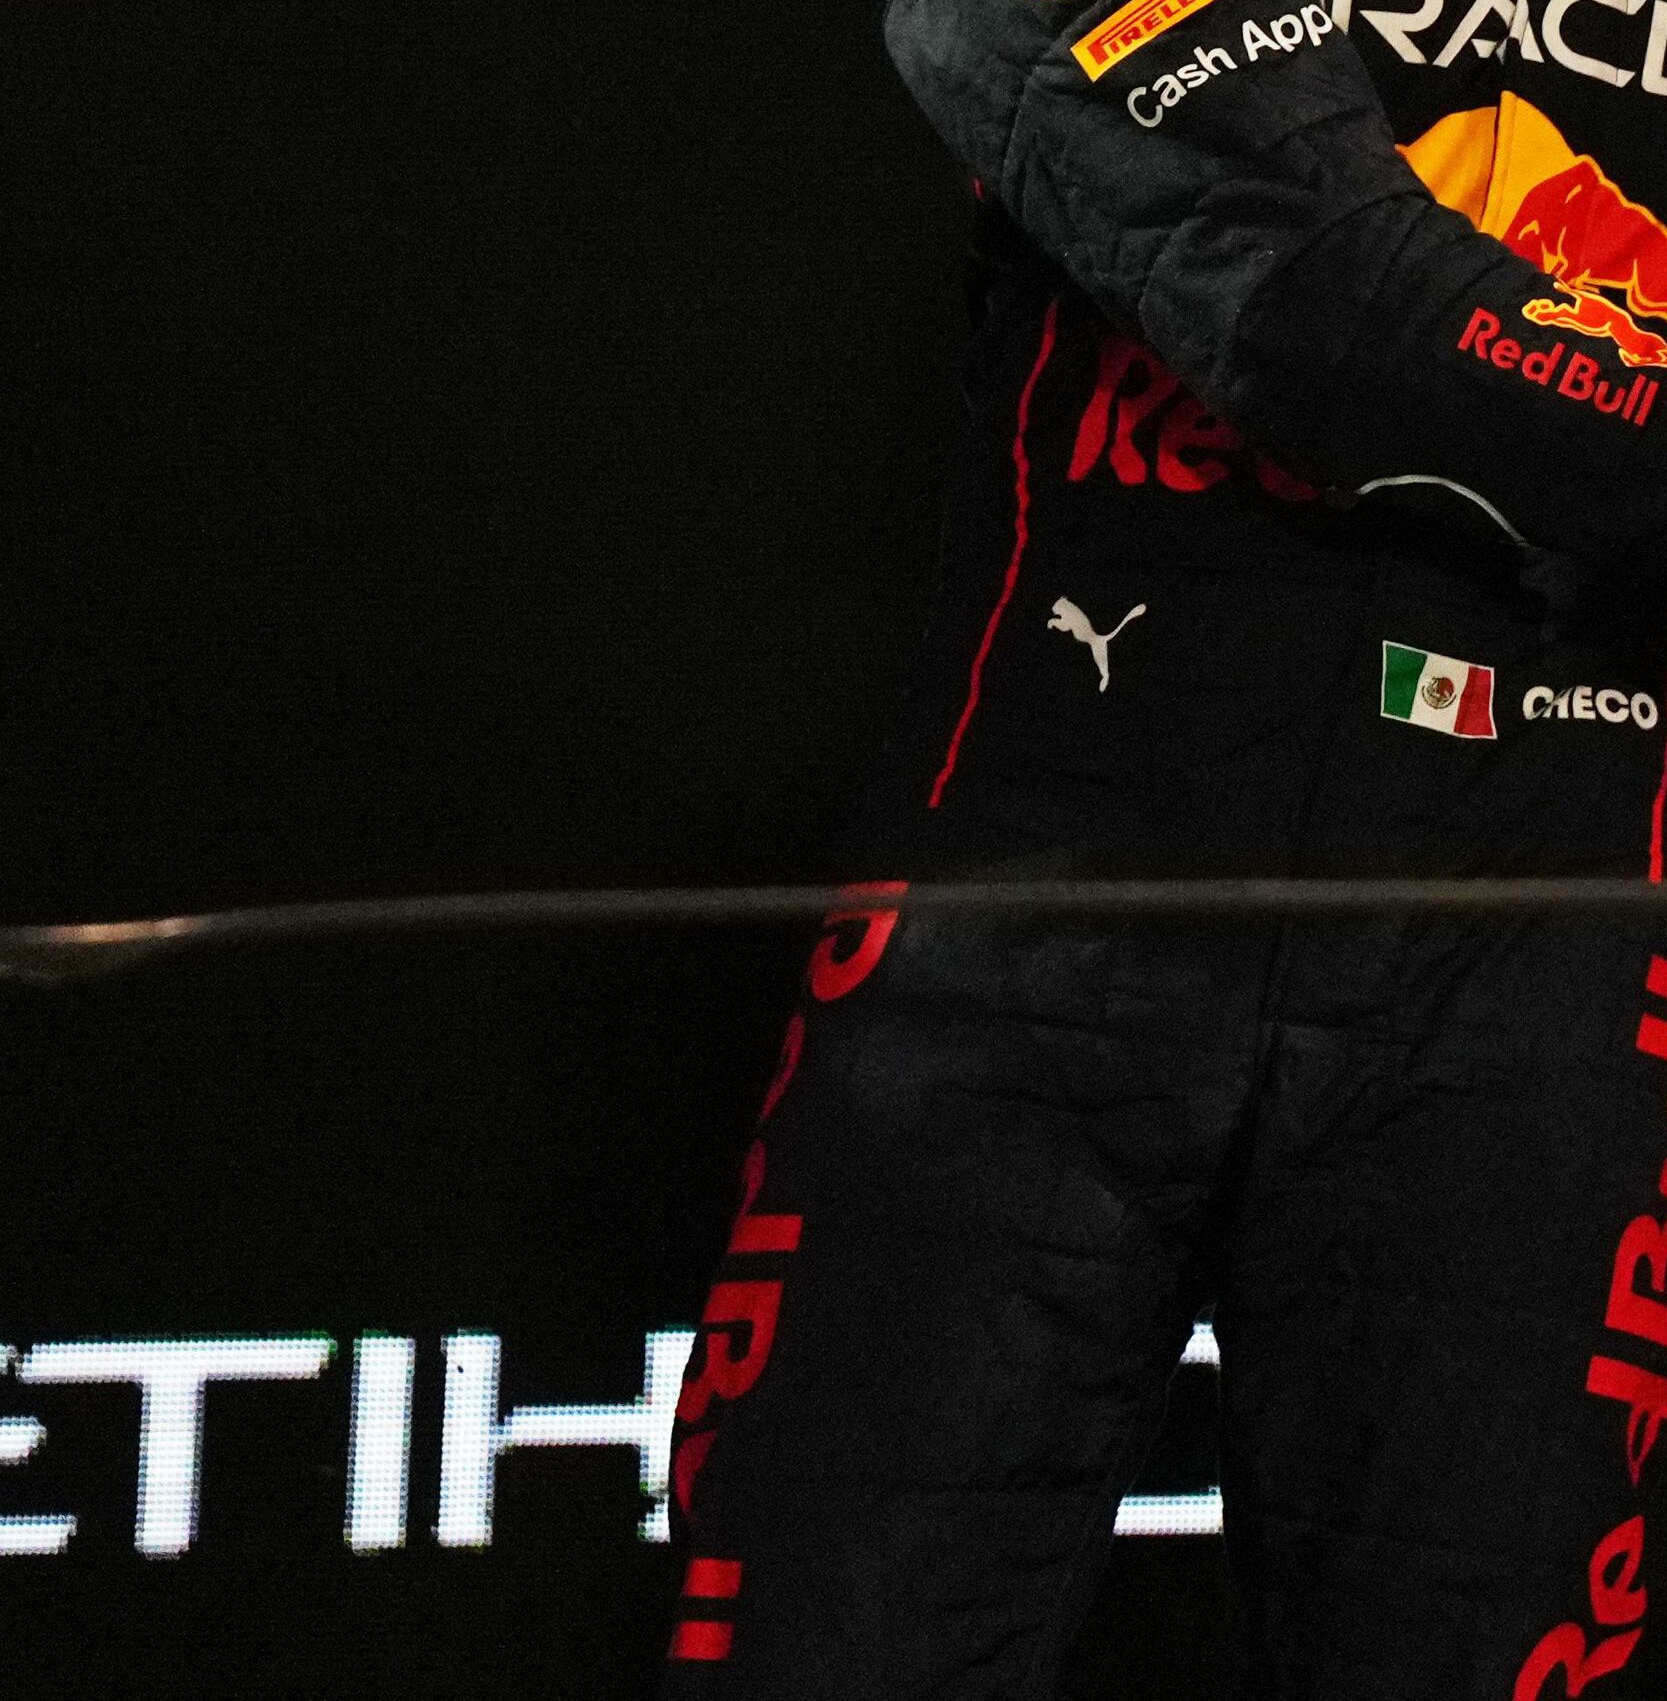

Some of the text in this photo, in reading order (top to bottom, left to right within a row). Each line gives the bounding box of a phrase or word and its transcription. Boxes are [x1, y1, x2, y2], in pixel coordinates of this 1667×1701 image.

[1127, 0, 1333, 129] Cash App
[1457, 307, 1660, 427] Red Bull
